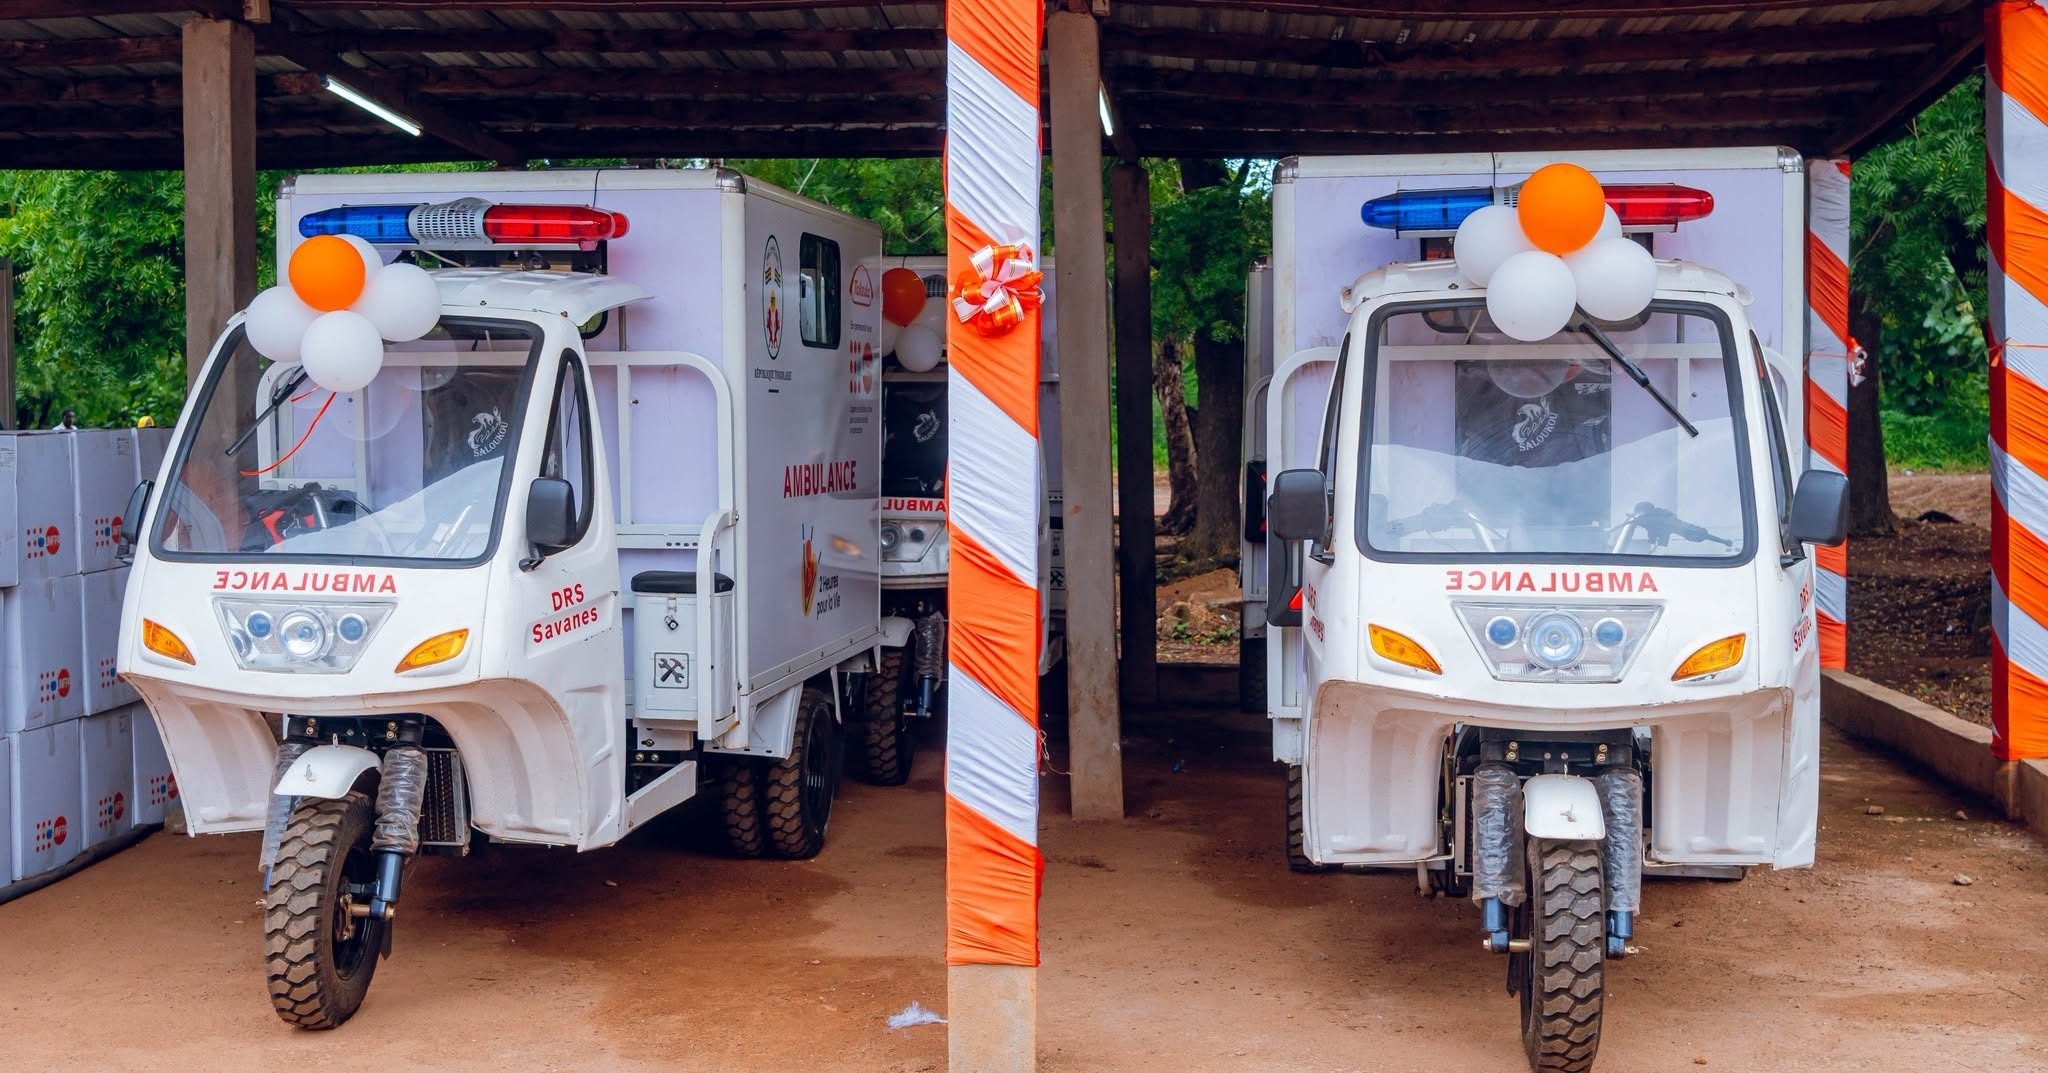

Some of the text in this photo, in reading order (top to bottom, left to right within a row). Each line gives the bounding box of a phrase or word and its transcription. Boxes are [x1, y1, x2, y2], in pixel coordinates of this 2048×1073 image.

[473, 421, 509, 457] SALOUKOU
[1519, 412, 1558, 452] SALOUKOU
[783, 460, 857, 499] AMBULANCE
[551, 583, 585, 611] DRS
[532, 606, 599, 643] Savanes
